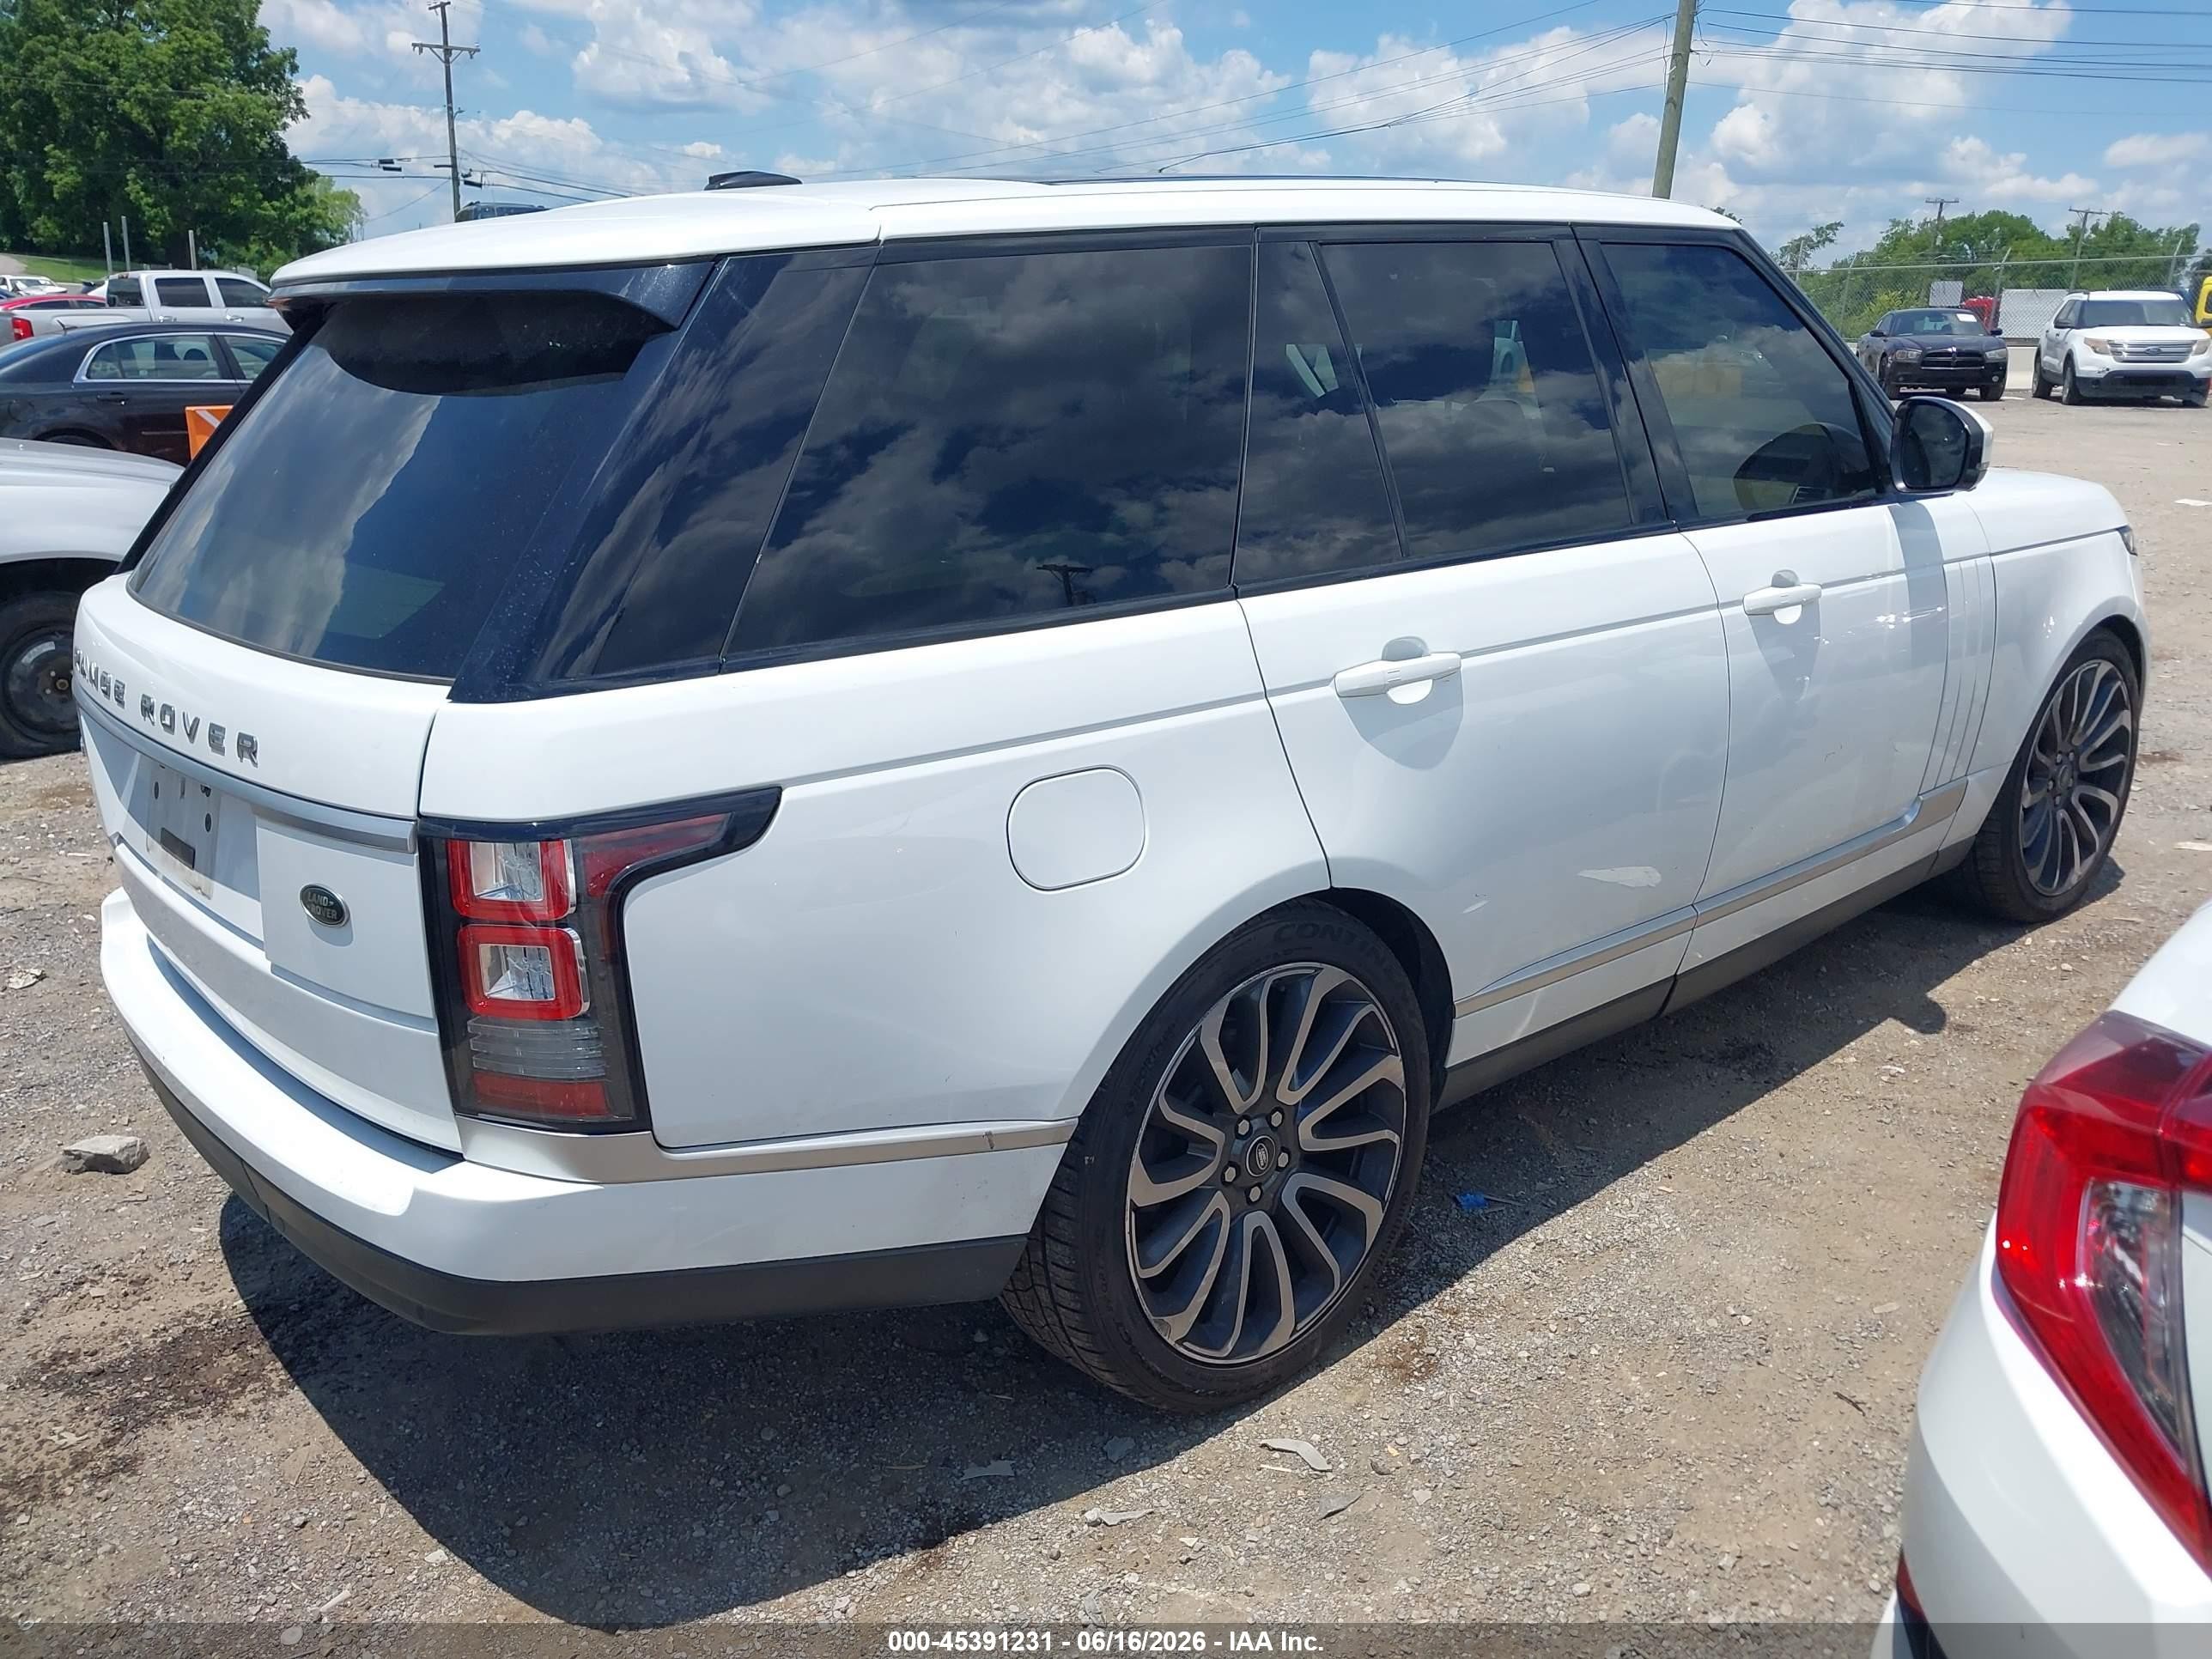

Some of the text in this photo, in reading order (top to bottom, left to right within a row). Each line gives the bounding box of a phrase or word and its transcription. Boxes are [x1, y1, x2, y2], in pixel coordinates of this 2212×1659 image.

[140, 694, 259, 769] ROVER
[307, 890, 329, 907] LAND
[310, 904, 337, 921] ROVER
